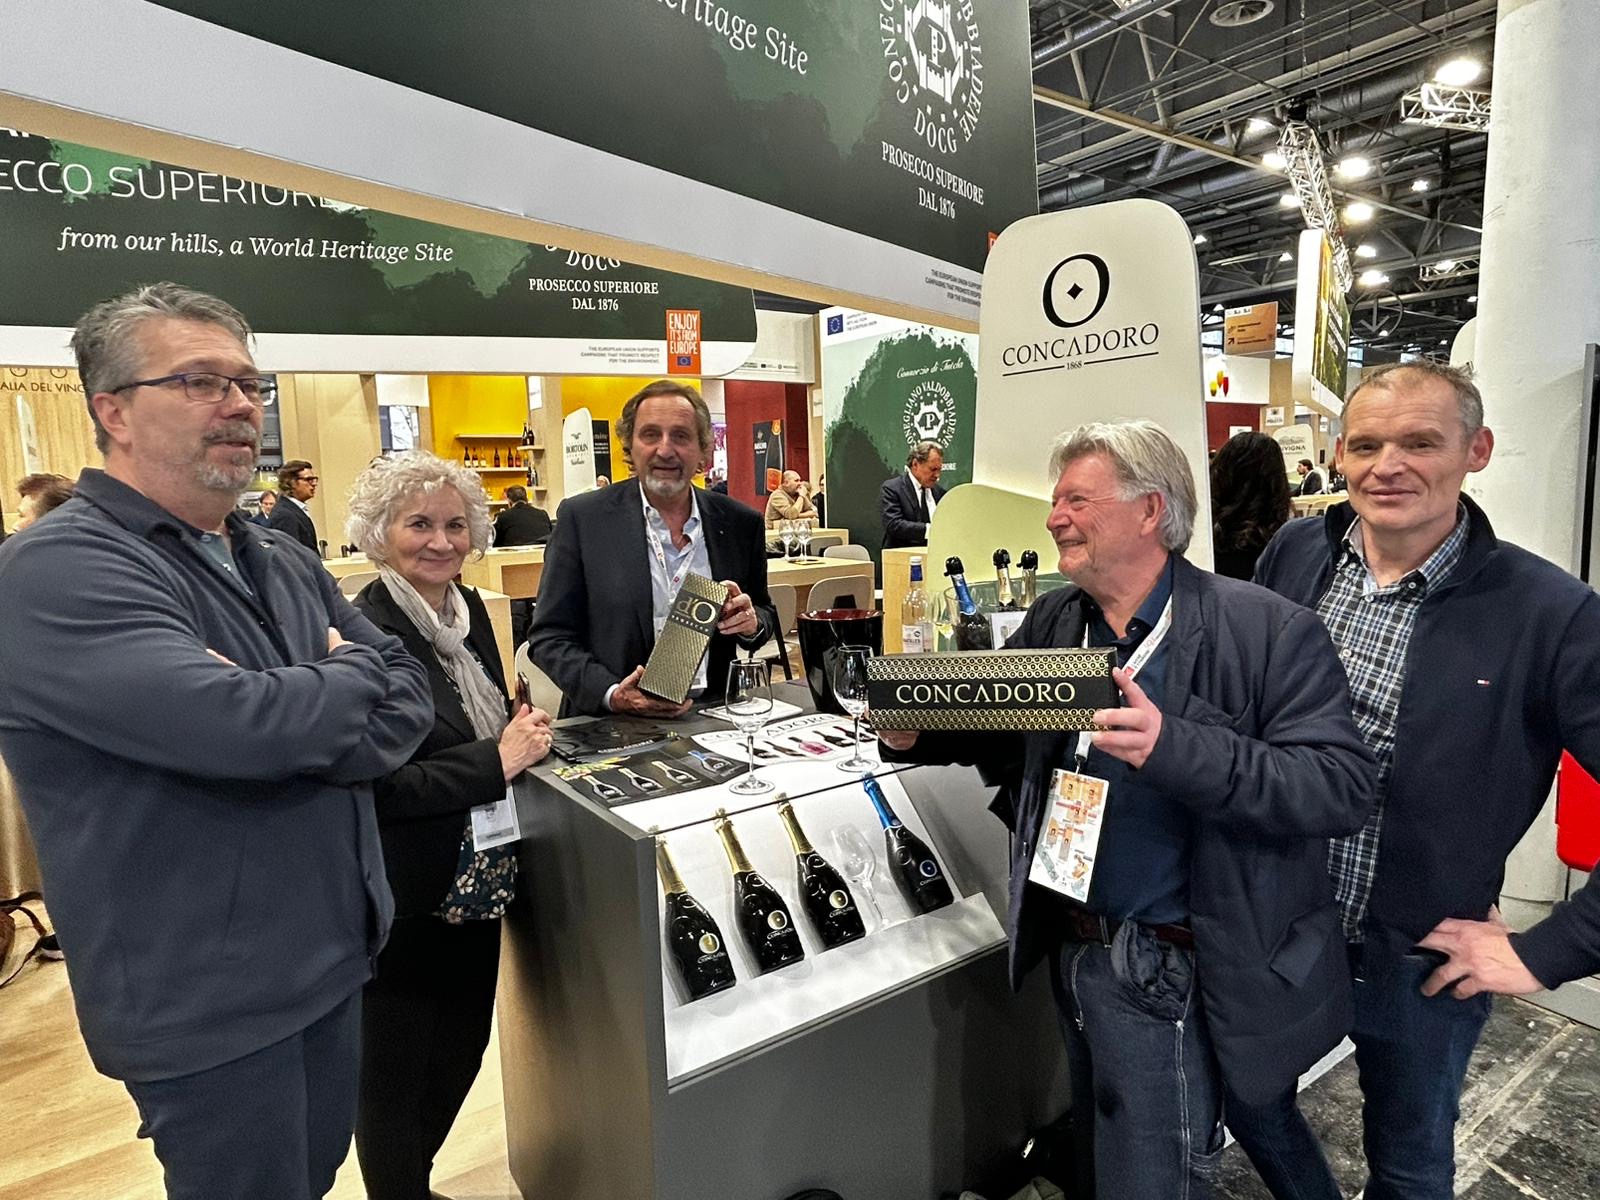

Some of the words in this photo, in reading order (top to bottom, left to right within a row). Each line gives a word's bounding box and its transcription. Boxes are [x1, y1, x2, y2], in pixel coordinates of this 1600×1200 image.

[658, 0, 758, 51] ritage
[765, 26, 808, 75] Site
[960, 0, 983, 142] BBIADENE
[914, 107, 957, 154] DOCG
[881, 141, 934, 182] PROSECCO
[935, 166, 985, 206] SUPERIORE
[918, 187, 938, 212] DAL
[939, 197, 956, 220] 1876
[57, 227, 118, 251] from
[125, 233, 166, 251] our
[170, 232, 224, 256] hills,
[229, 238, 244, 255] a
[249, 237, 314, 257] World
[320, 240, 409, 263] Heritage
[414, 243, 454, 262] Site
[529, 278, 591, 293] PROSECCO
[593, 281, 659, 294] SUPERIORE
[572, 297, 596, 310] DAL
[597, 298, 619, 311] 1876
[669, 313, 698, 330] ENJOY
[682, 330, 697, 340] FROM
[1002, 323, 1159, 367] CONCADORO
[670, 341, 698, 355] EUROPE
[1066, 361, 1083, 370] 1868
[0, 382, 27, 391] ALIA
[31, 382, 52, 392] DEL
[896, 682, 1076, 704] CONCADORO
